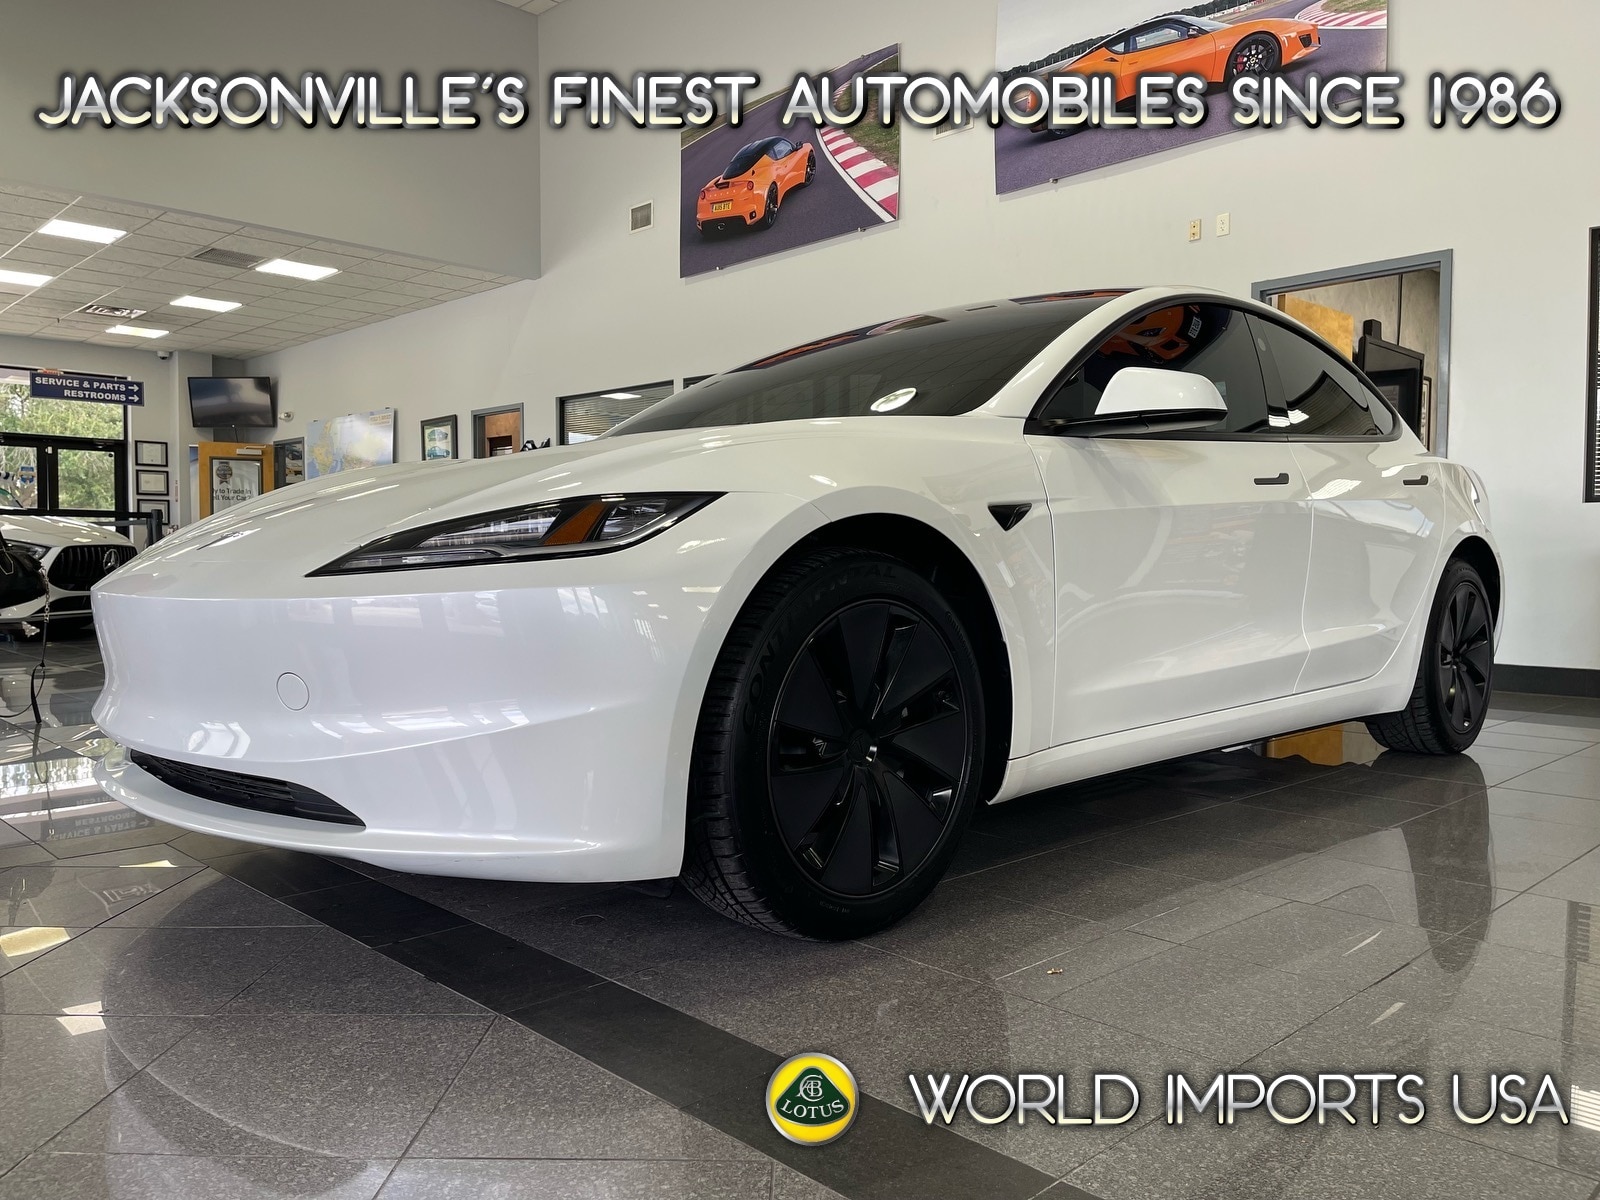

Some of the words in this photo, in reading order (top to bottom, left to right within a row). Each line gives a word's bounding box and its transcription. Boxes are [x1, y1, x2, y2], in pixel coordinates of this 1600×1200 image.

[35, 376, 79, 387] SERVICE
[93, 382, 126, 391] PARTS
[64, 389, 126, 401] RESTROOMS
